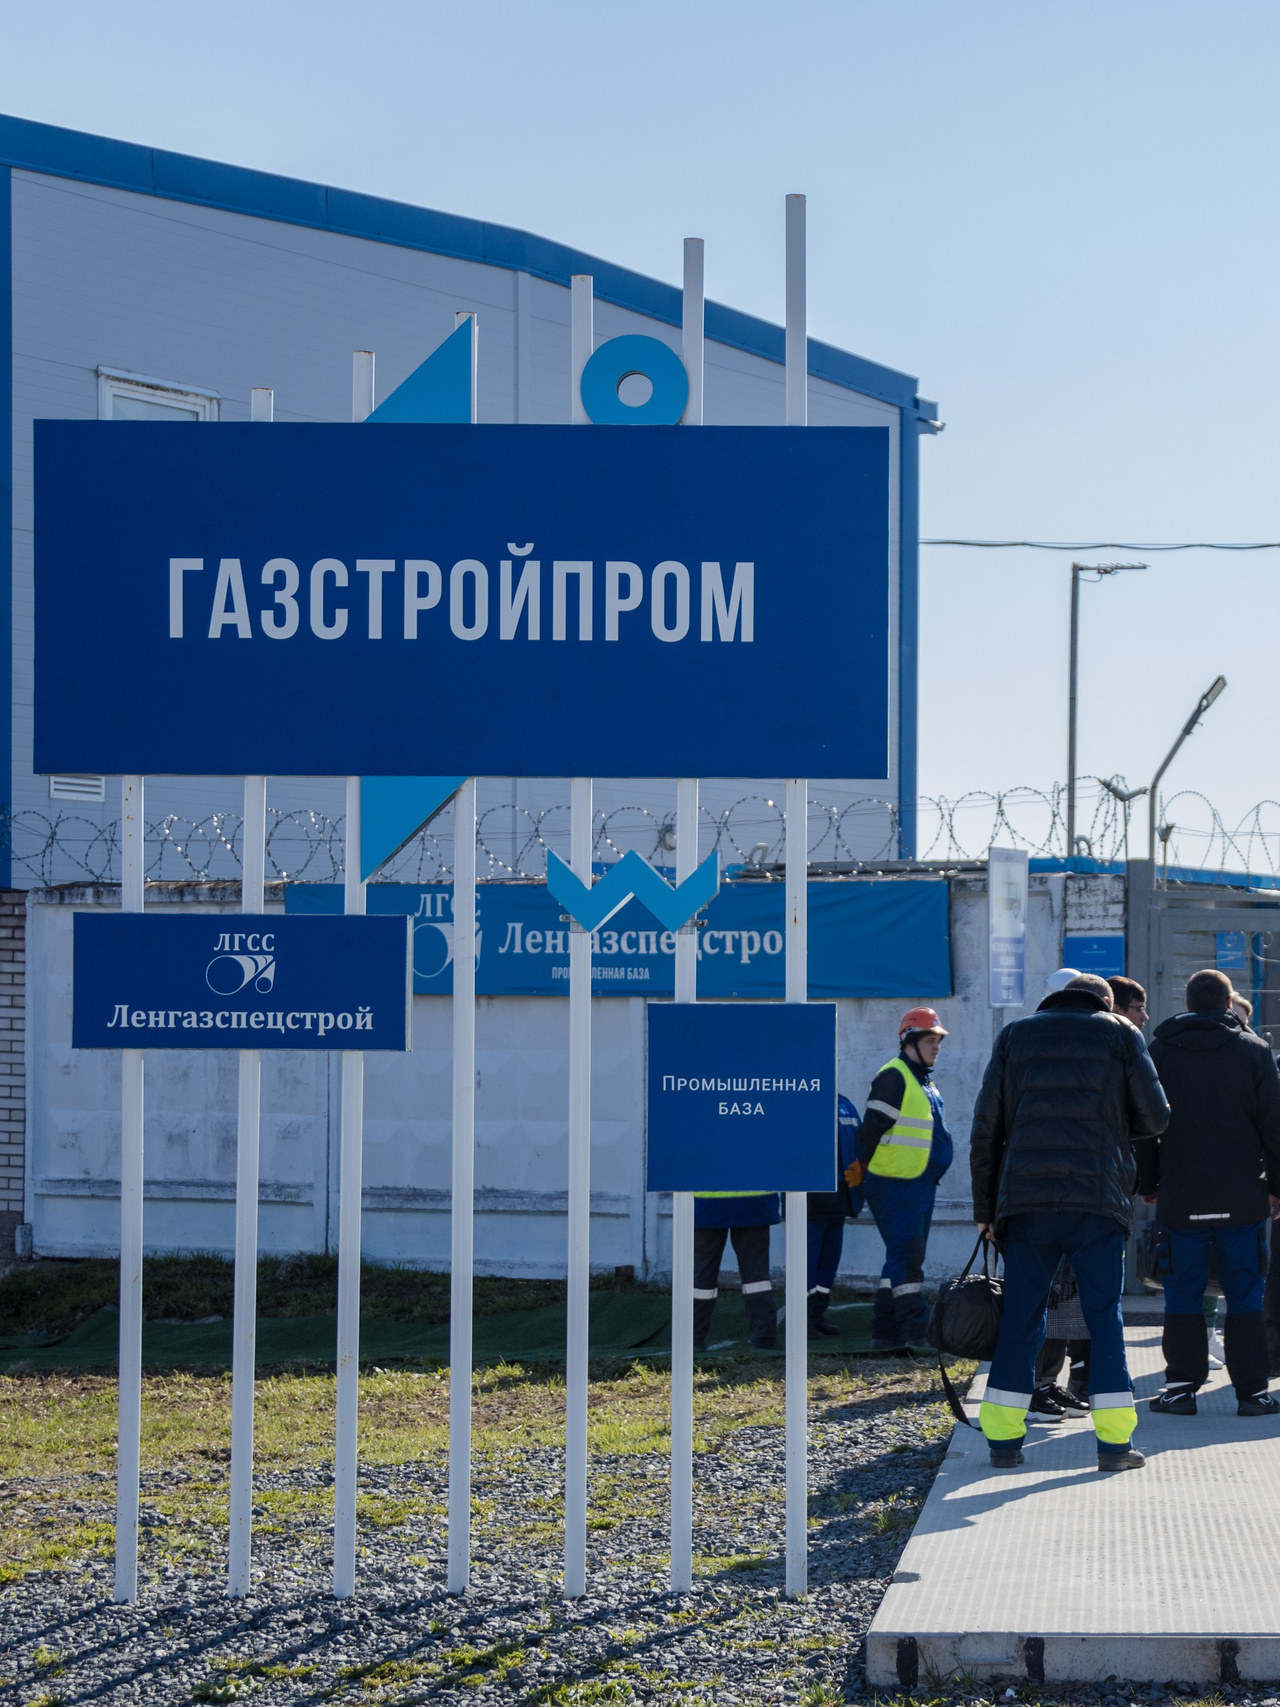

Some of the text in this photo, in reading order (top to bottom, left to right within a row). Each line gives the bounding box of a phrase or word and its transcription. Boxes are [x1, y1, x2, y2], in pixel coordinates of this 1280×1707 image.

[169, 543, 755, 643] ГАЗСТРОЙПРОМ
[414, 893, 481, 918] ЛГ
[213, 933, 275, 952] ЛГСС
[498, 922, 807, 964] Леназспестро
[551, 966, 651, 980] ПРОЛЕННАЯ БАЗА
[107, 1004, 374, 1036] Ленгазспецстрой
